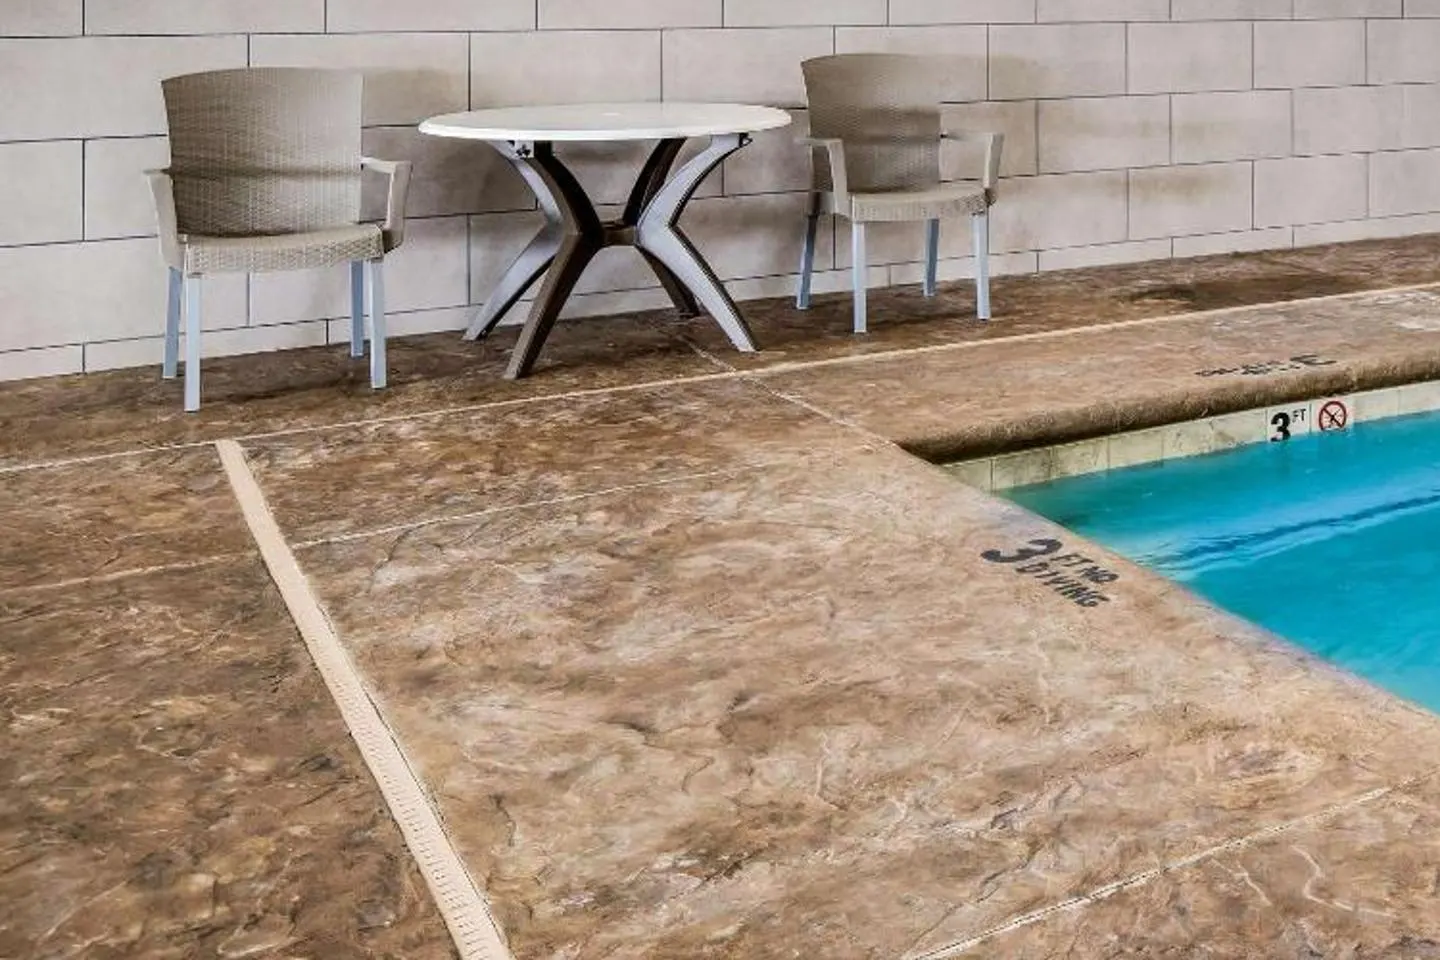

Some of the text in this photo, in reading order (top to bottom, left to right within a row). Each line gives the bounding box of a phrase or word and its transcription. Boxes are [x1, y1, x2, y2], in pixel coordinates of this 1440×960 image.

[1270, 408, 1307, 442] 3 FT
[980, 538, 1063, 563] 3
[1015, 562, 1110, 607] DIVING
